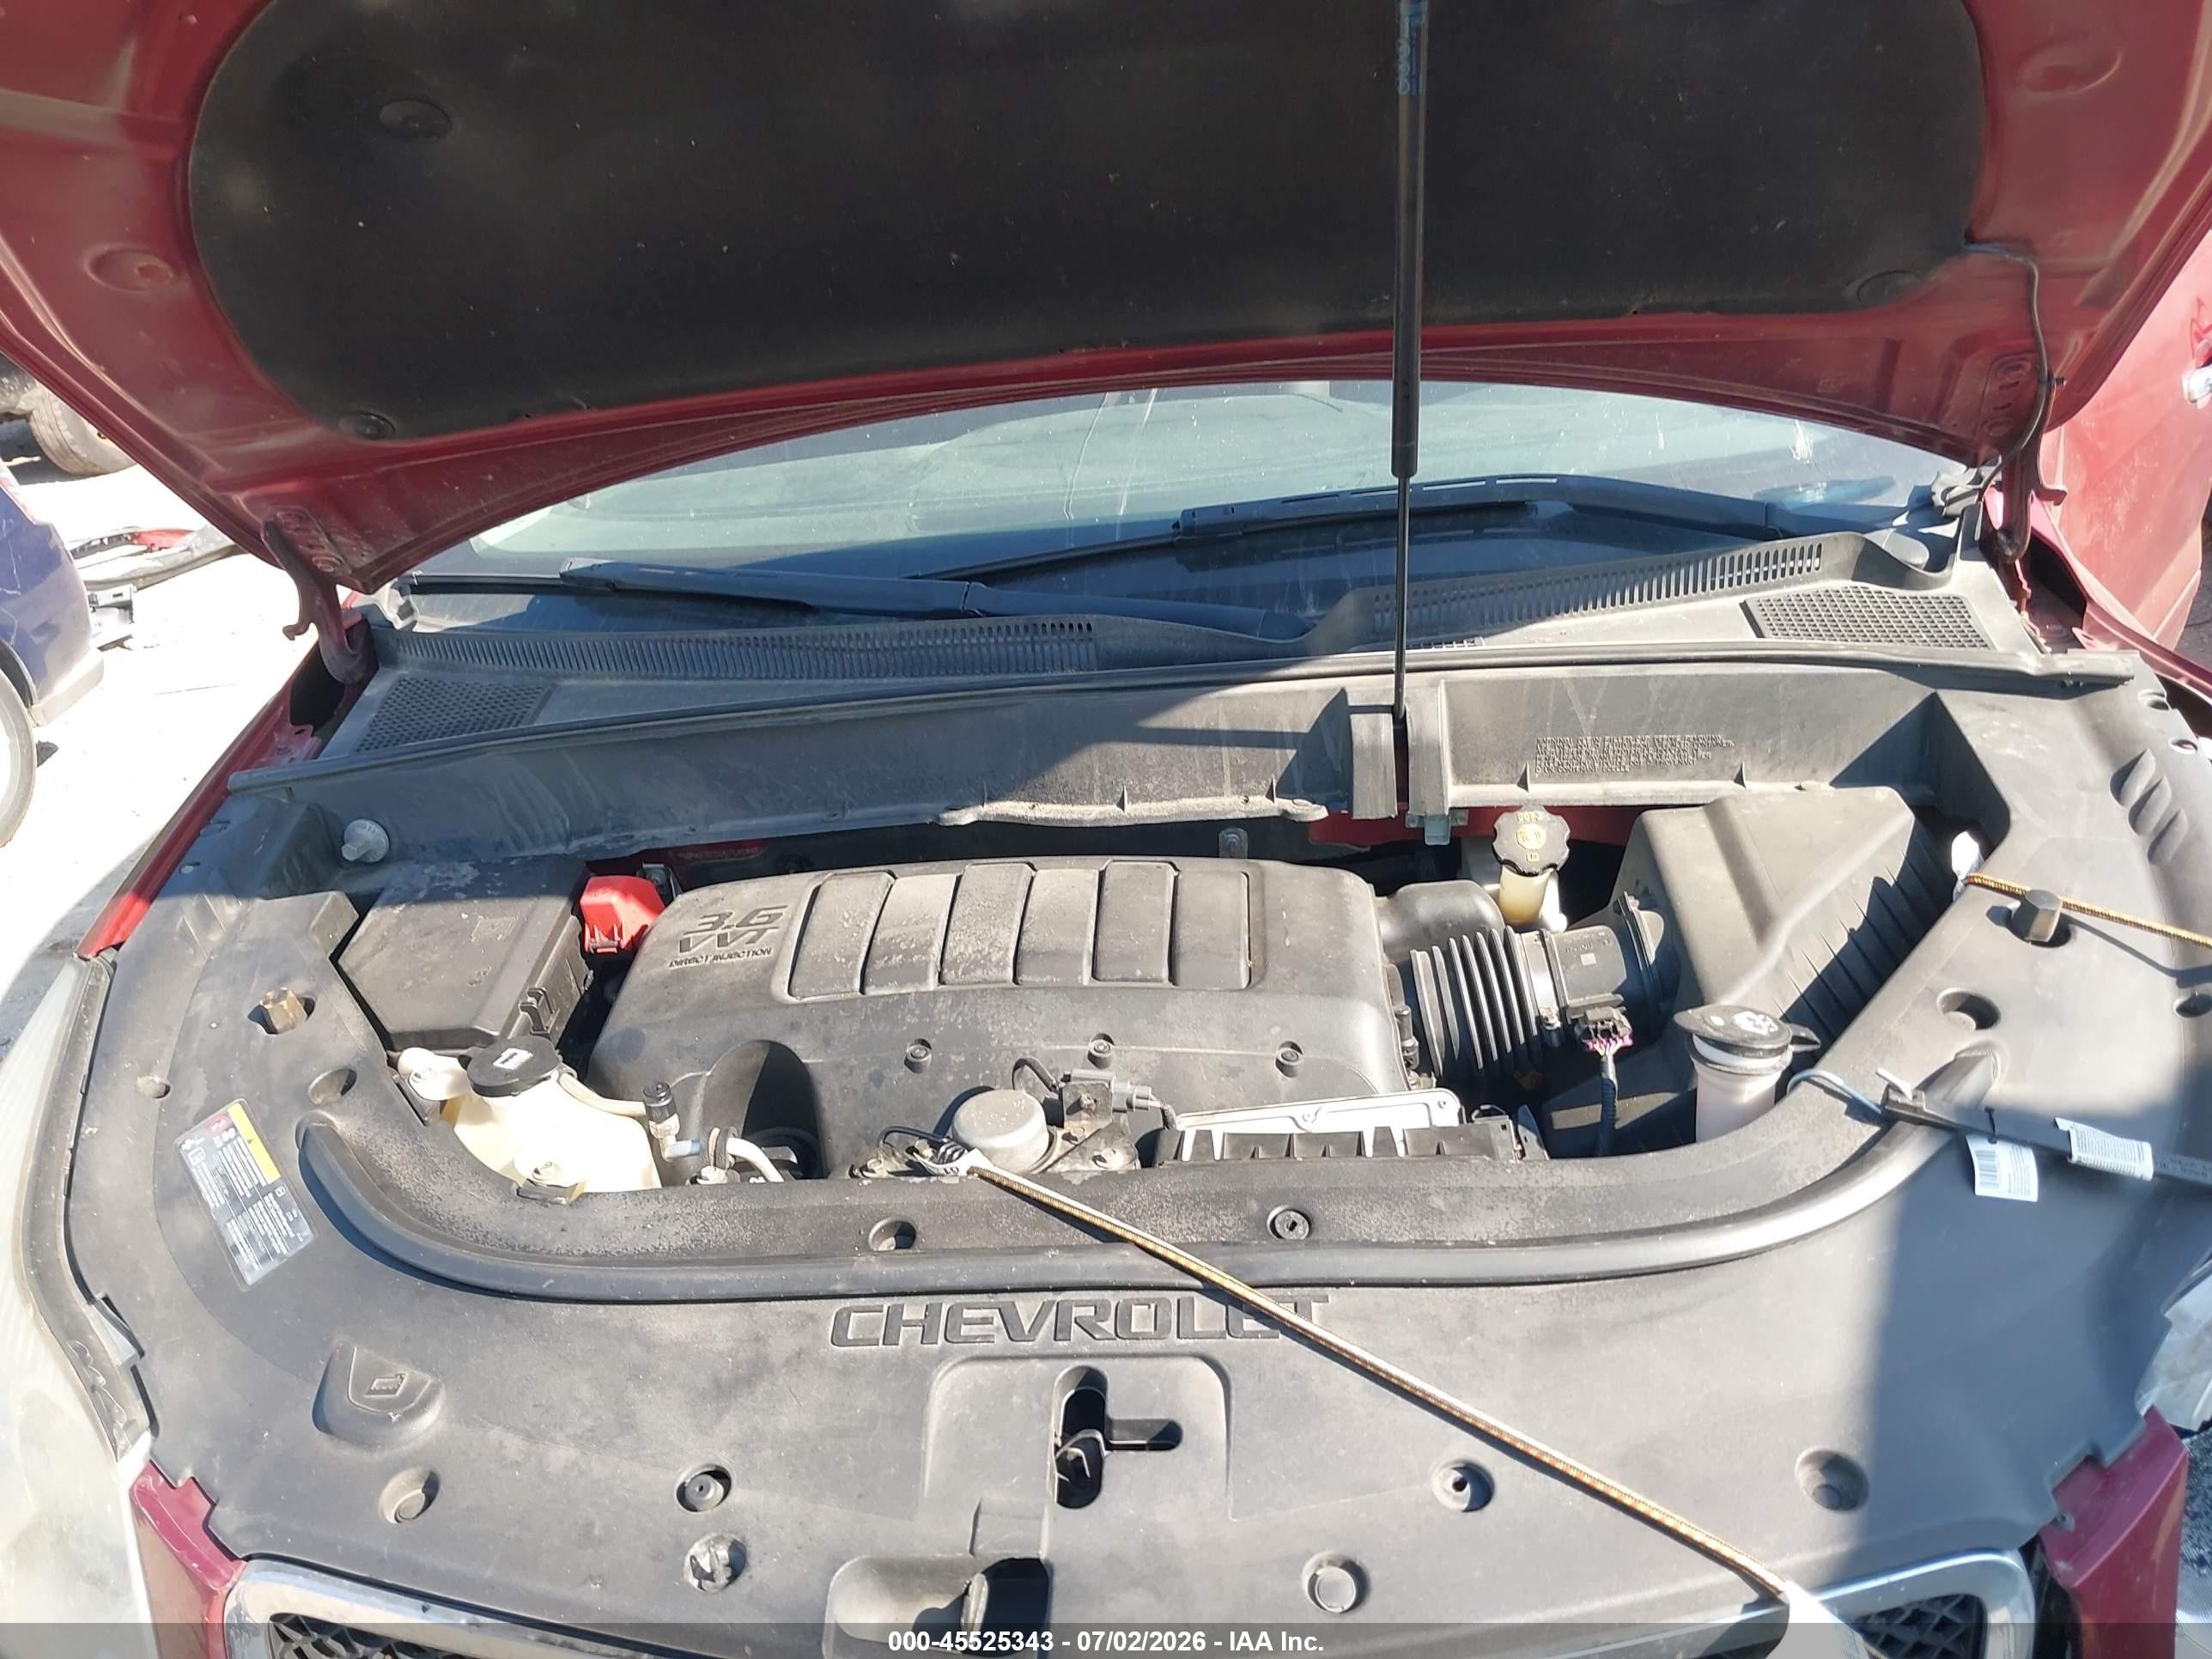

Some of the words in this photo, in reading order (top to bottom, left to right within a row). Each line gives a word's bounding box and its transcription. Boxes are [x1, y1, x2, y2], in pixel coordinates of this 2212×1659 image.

[684, 905, 788, 935] 3.6
[679, 927, 780, 953] VVT
[669, 955, 710, 968] DIRECT
[712, 947, 772, 962] INJECTION
[830, 1294, 1330, 1346] CHEVROLET
